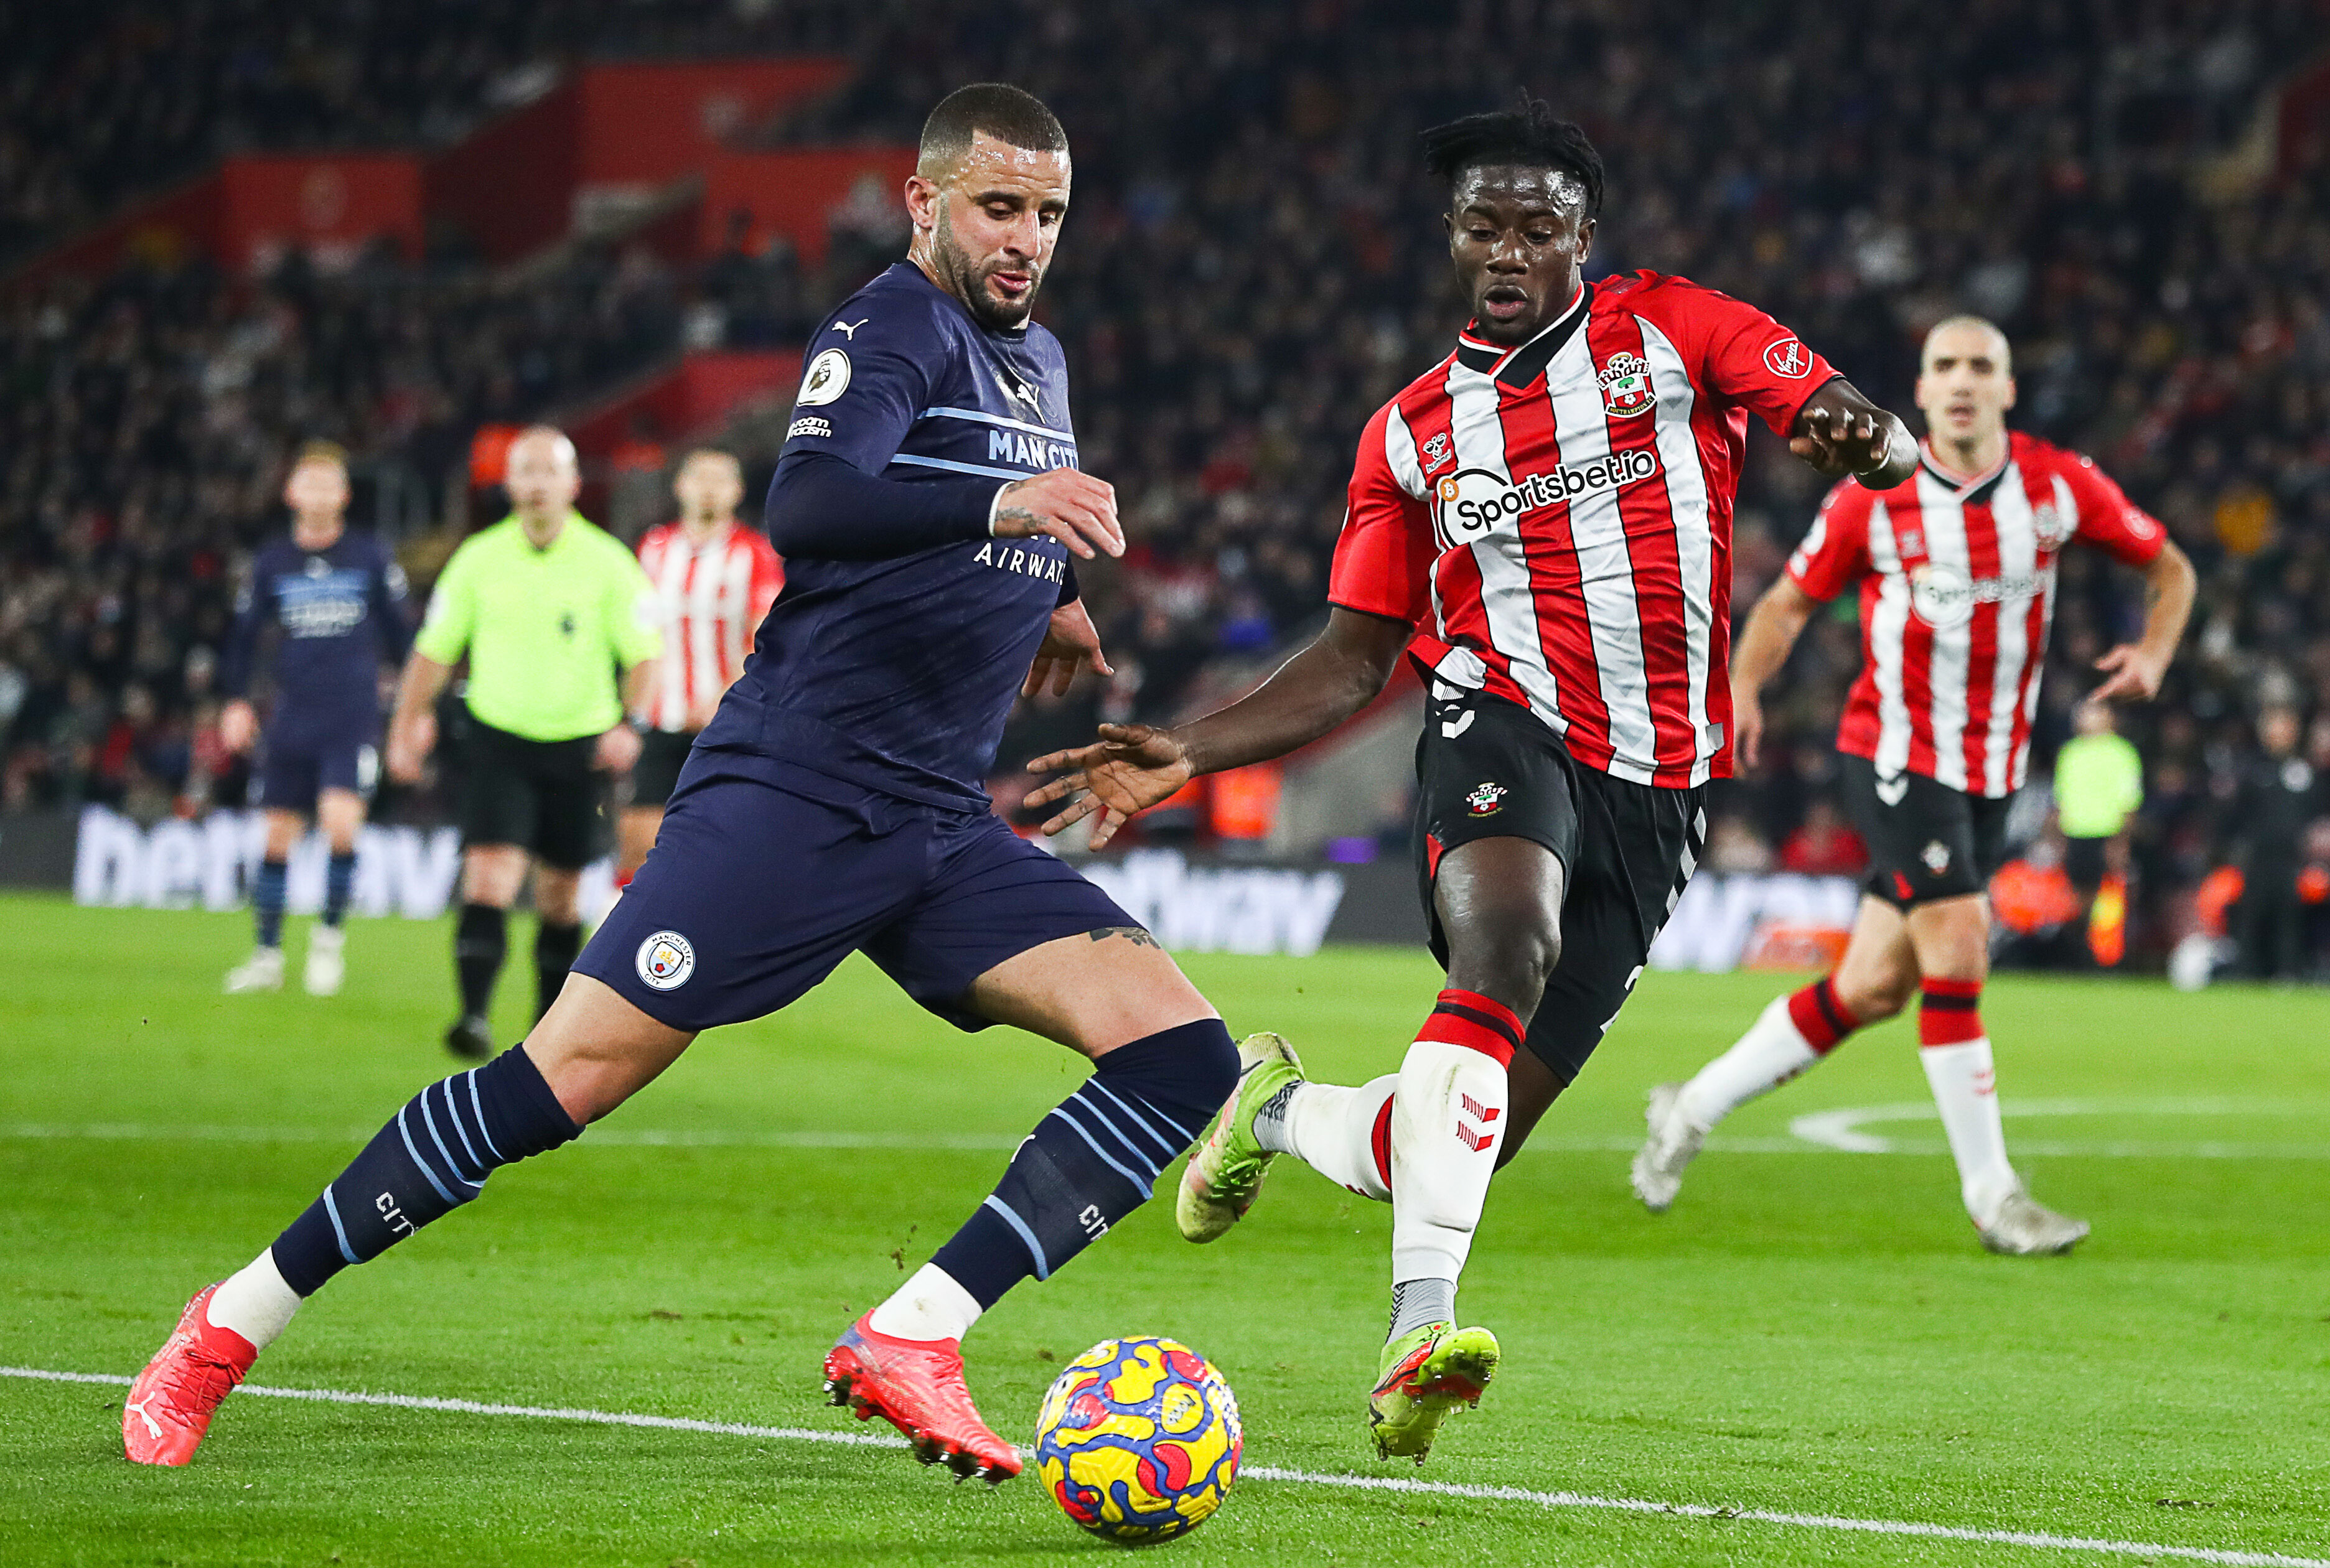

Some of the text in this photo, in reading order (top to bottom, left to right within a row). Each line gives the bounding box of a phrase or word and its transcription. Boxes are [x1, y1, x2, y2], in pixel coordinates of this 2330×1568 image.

[1774, 342, 1806, 374] Virgin
[989, 429, 1046, 470] MAN
[1457, 450, 1654, 533] Sportsbet.io
[652, 935, 691, 966] MANCHESTER
[644, 973, 660, 986] CITY
[375, 1192, 419, 1236] CIT
